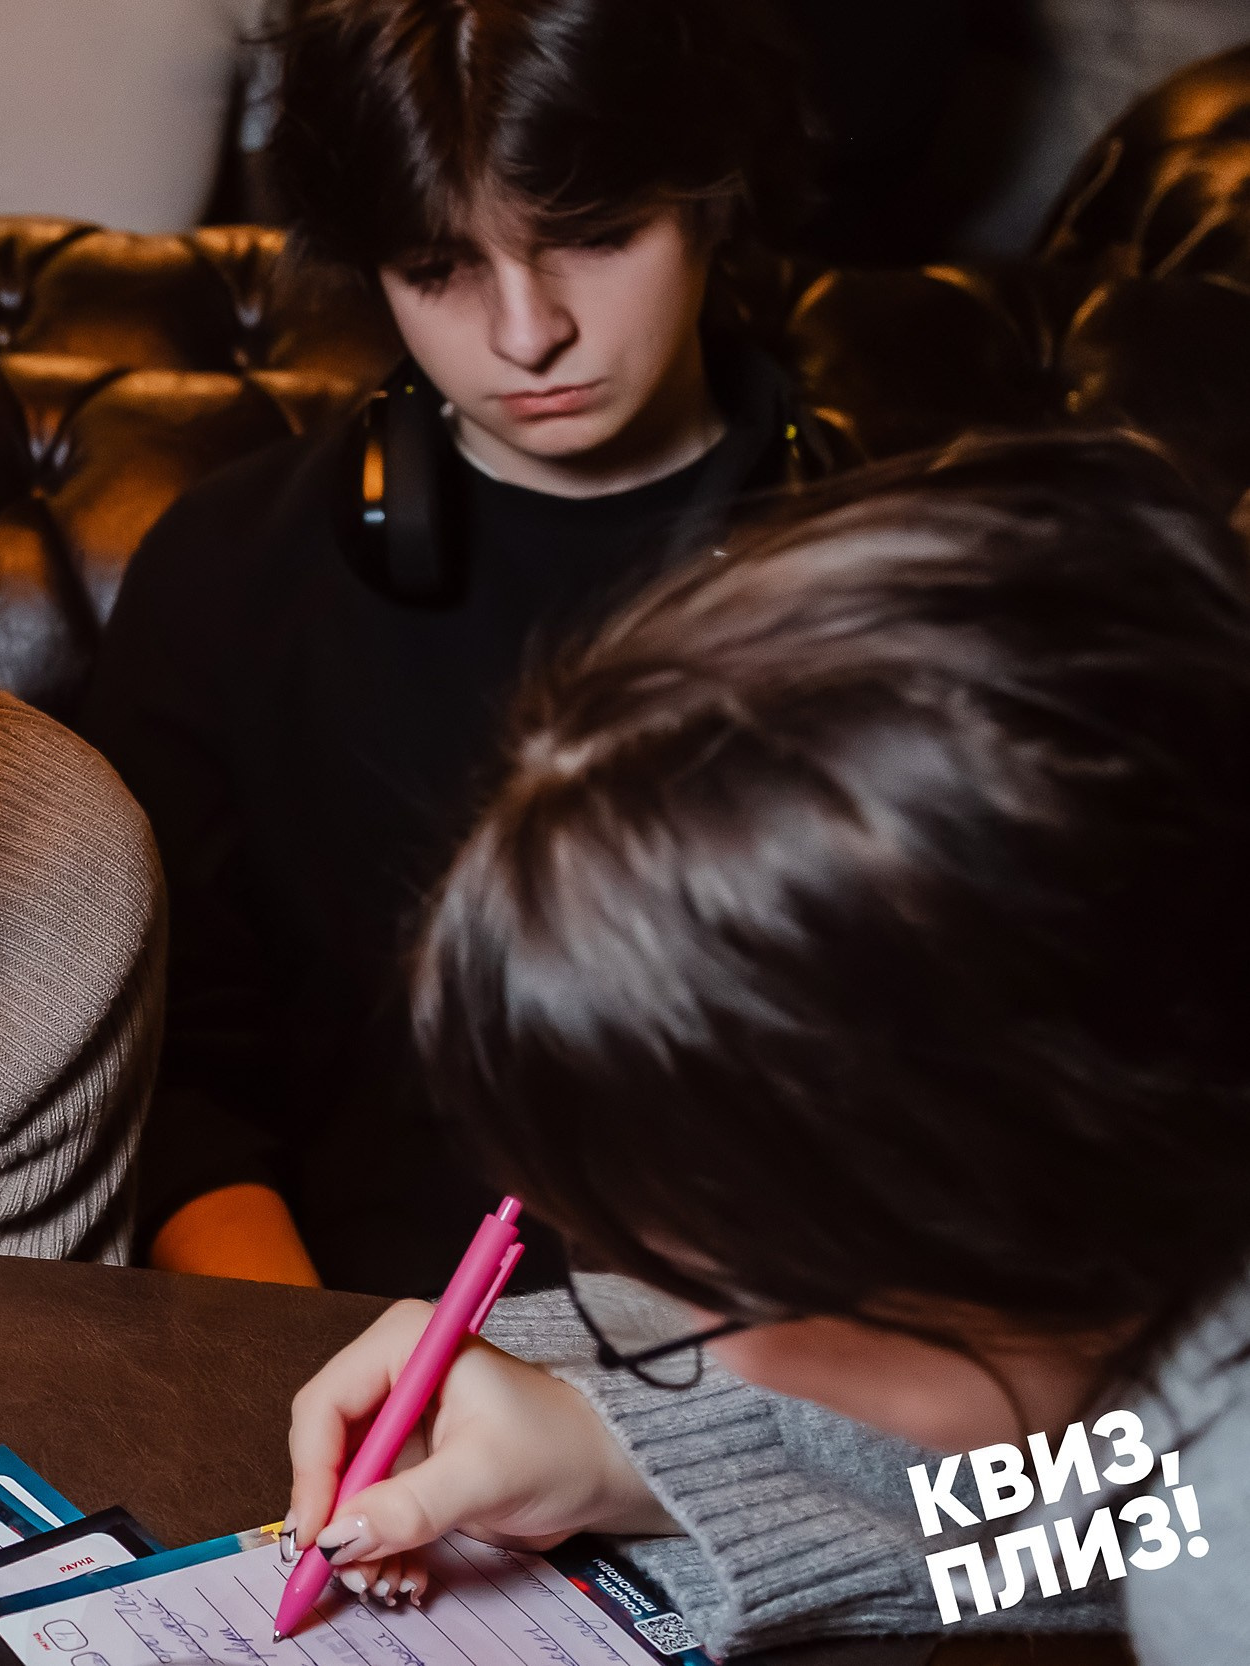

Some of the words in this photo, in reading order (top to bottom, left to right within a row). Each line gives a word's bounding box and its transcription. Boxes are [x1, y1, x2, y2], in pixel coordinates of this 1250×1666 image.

[59, 1556, 106, 1574] РАУНД
[592, 1558, 657, 1613] ПРОМОКОДЫ
[595, 1574, 642, 1616] СОЦСЕТИ,
